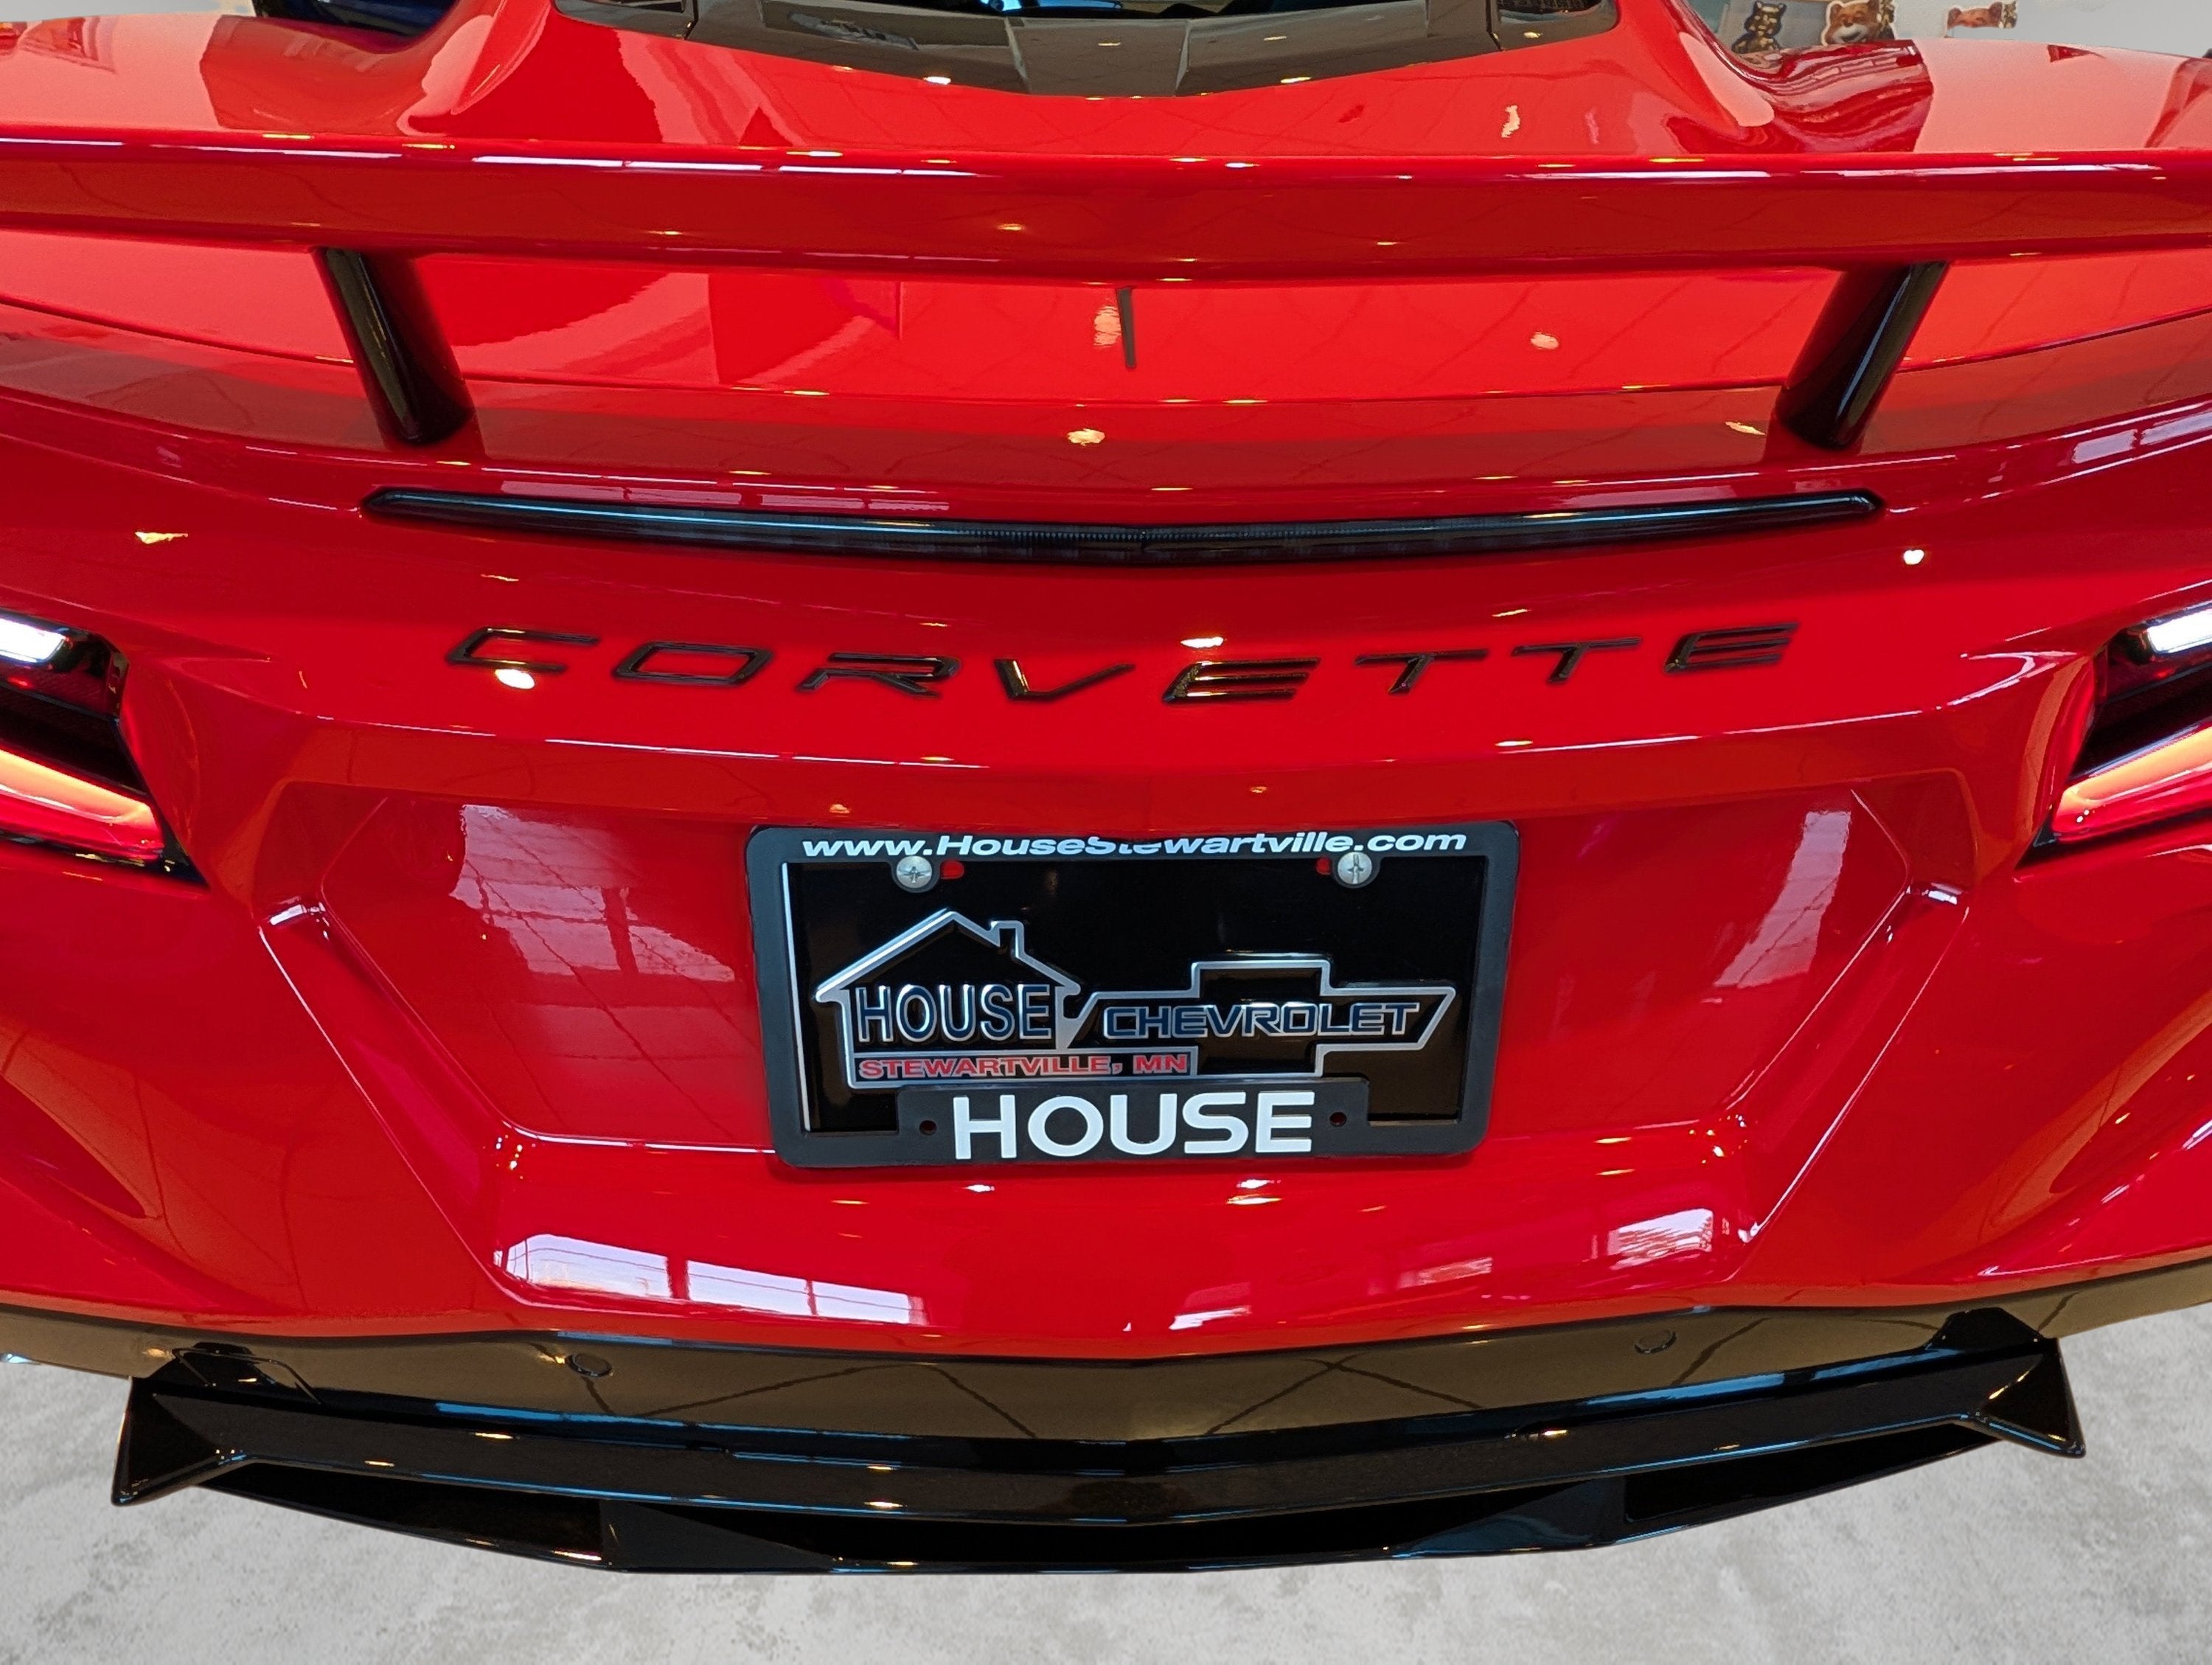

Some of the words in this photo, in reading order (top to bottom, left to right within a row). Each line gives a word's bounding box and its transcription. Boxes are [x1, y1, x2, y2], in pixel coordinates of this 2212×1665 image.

[446, 622, 1799, 704] CORVETTE
[855, 984, 1052, 1042] HOUSE
[1104, 1001, 1420, 1038] CHEVROLET
[858, 1055, 1123, 1079] STEWARTVILLE,
[1133, 1054, 1187, 1074] MN
[952, 1091, 1316, 1160] HOUSE
